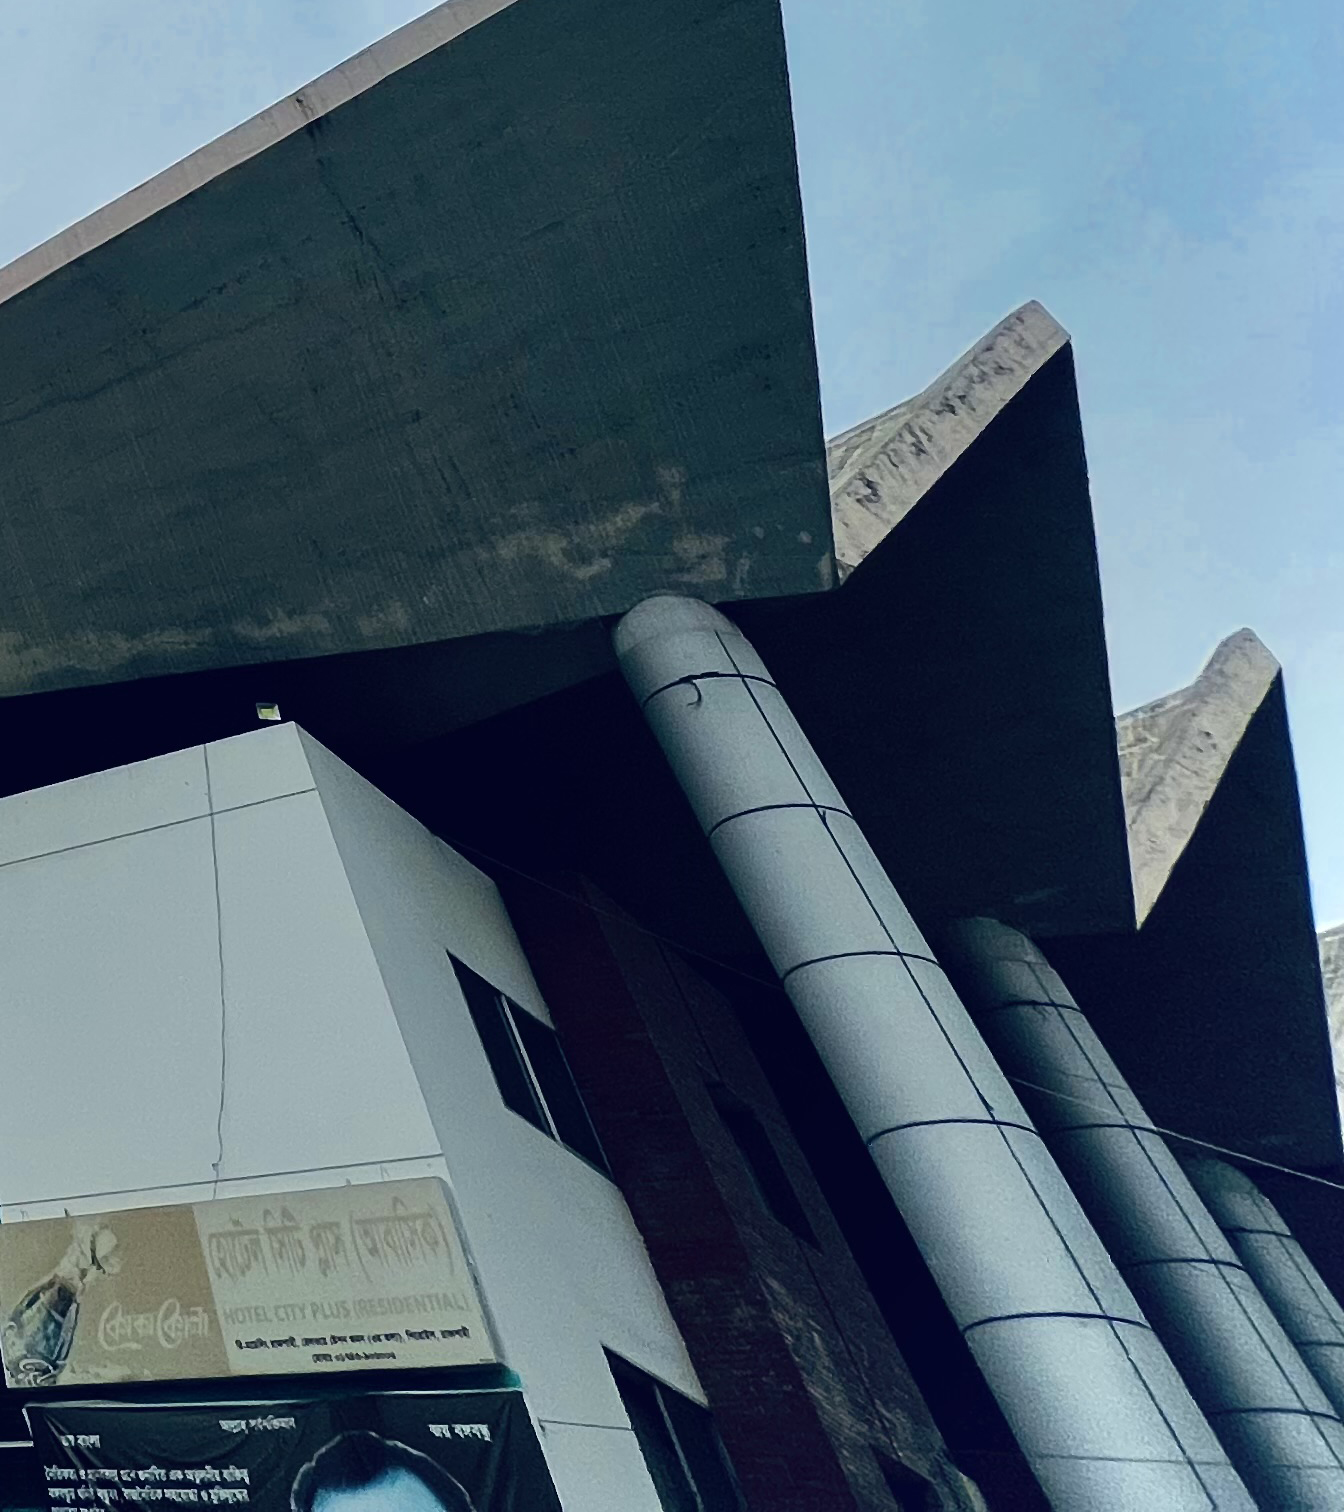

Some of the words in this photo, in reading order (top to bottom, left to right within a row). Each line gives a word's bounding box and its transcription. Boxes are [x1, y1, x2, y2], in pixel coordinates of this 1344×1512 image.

[223, 1303, 273, 1326] HOTEL
[274, 1301, 308, 1322] CITY
[312, 1299, 350, 1320] PLUS
[352, 1292, 473, 1320] (RESIDENTIAL)
